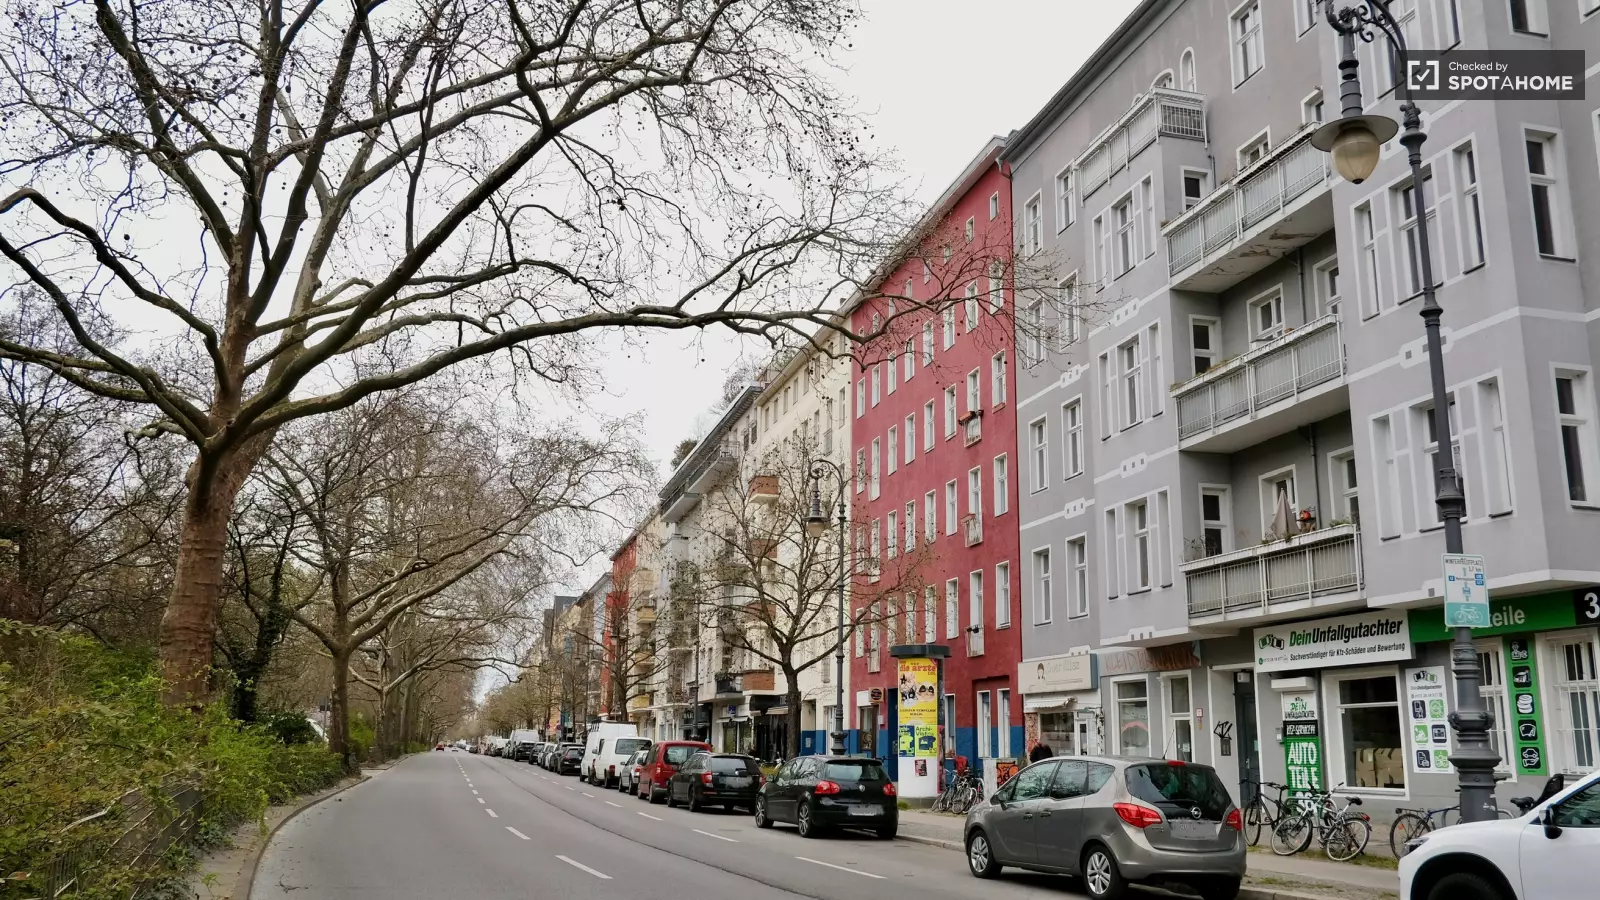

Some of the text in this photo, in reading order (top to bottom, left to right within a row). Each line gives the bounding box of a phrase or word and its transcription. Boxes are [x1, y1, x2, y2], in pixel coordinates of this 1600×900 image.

[1290, 651, 1328, 661] Sachverständiger
[1328, 650, 1336, 658] für
[1336, 646, 1366, 656] Kfz-Schäden
[1366, 645, 1377, 654] und
[1377, 642, 1406, 653] Bewertung
[1290, 701, 1308, 711] DEIN
[1287, 741, 1318, 765] AUTO
[1288, 765, 1320, 789] TEILE
